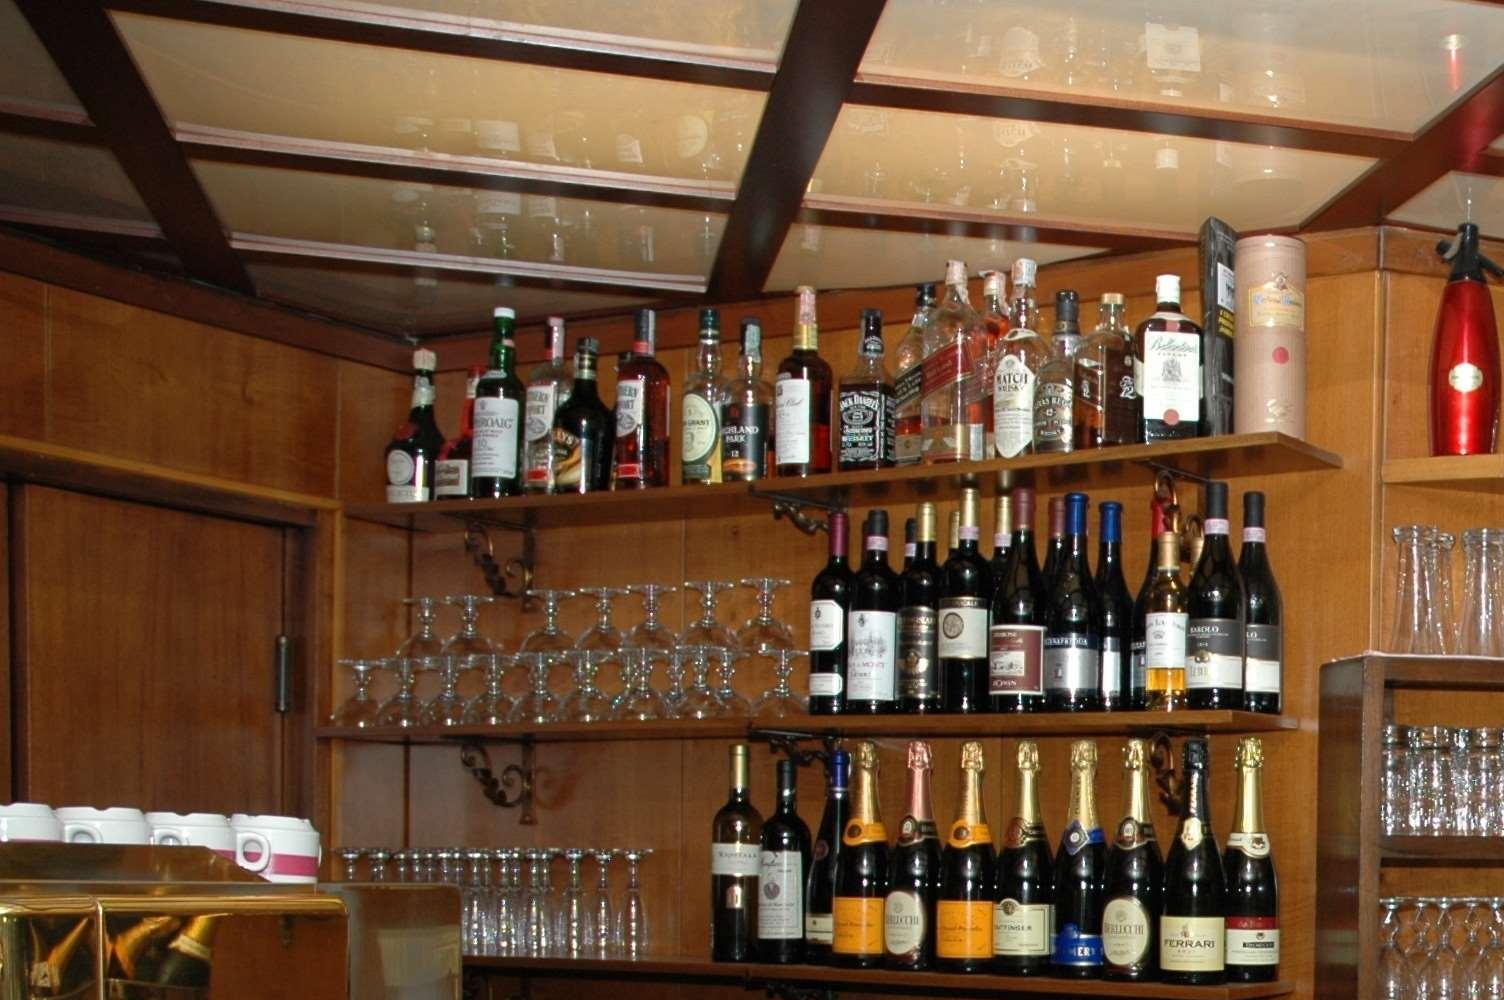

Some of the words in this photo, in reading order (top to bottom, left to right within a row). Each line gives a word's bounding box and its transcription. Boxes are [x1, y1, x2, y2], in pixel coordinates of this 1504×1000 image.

[725, 434, 746, 443] PARK
[1189, 626, 1220, 634] BAROLO
[1163, 938, 1216, 949] FERRARI
